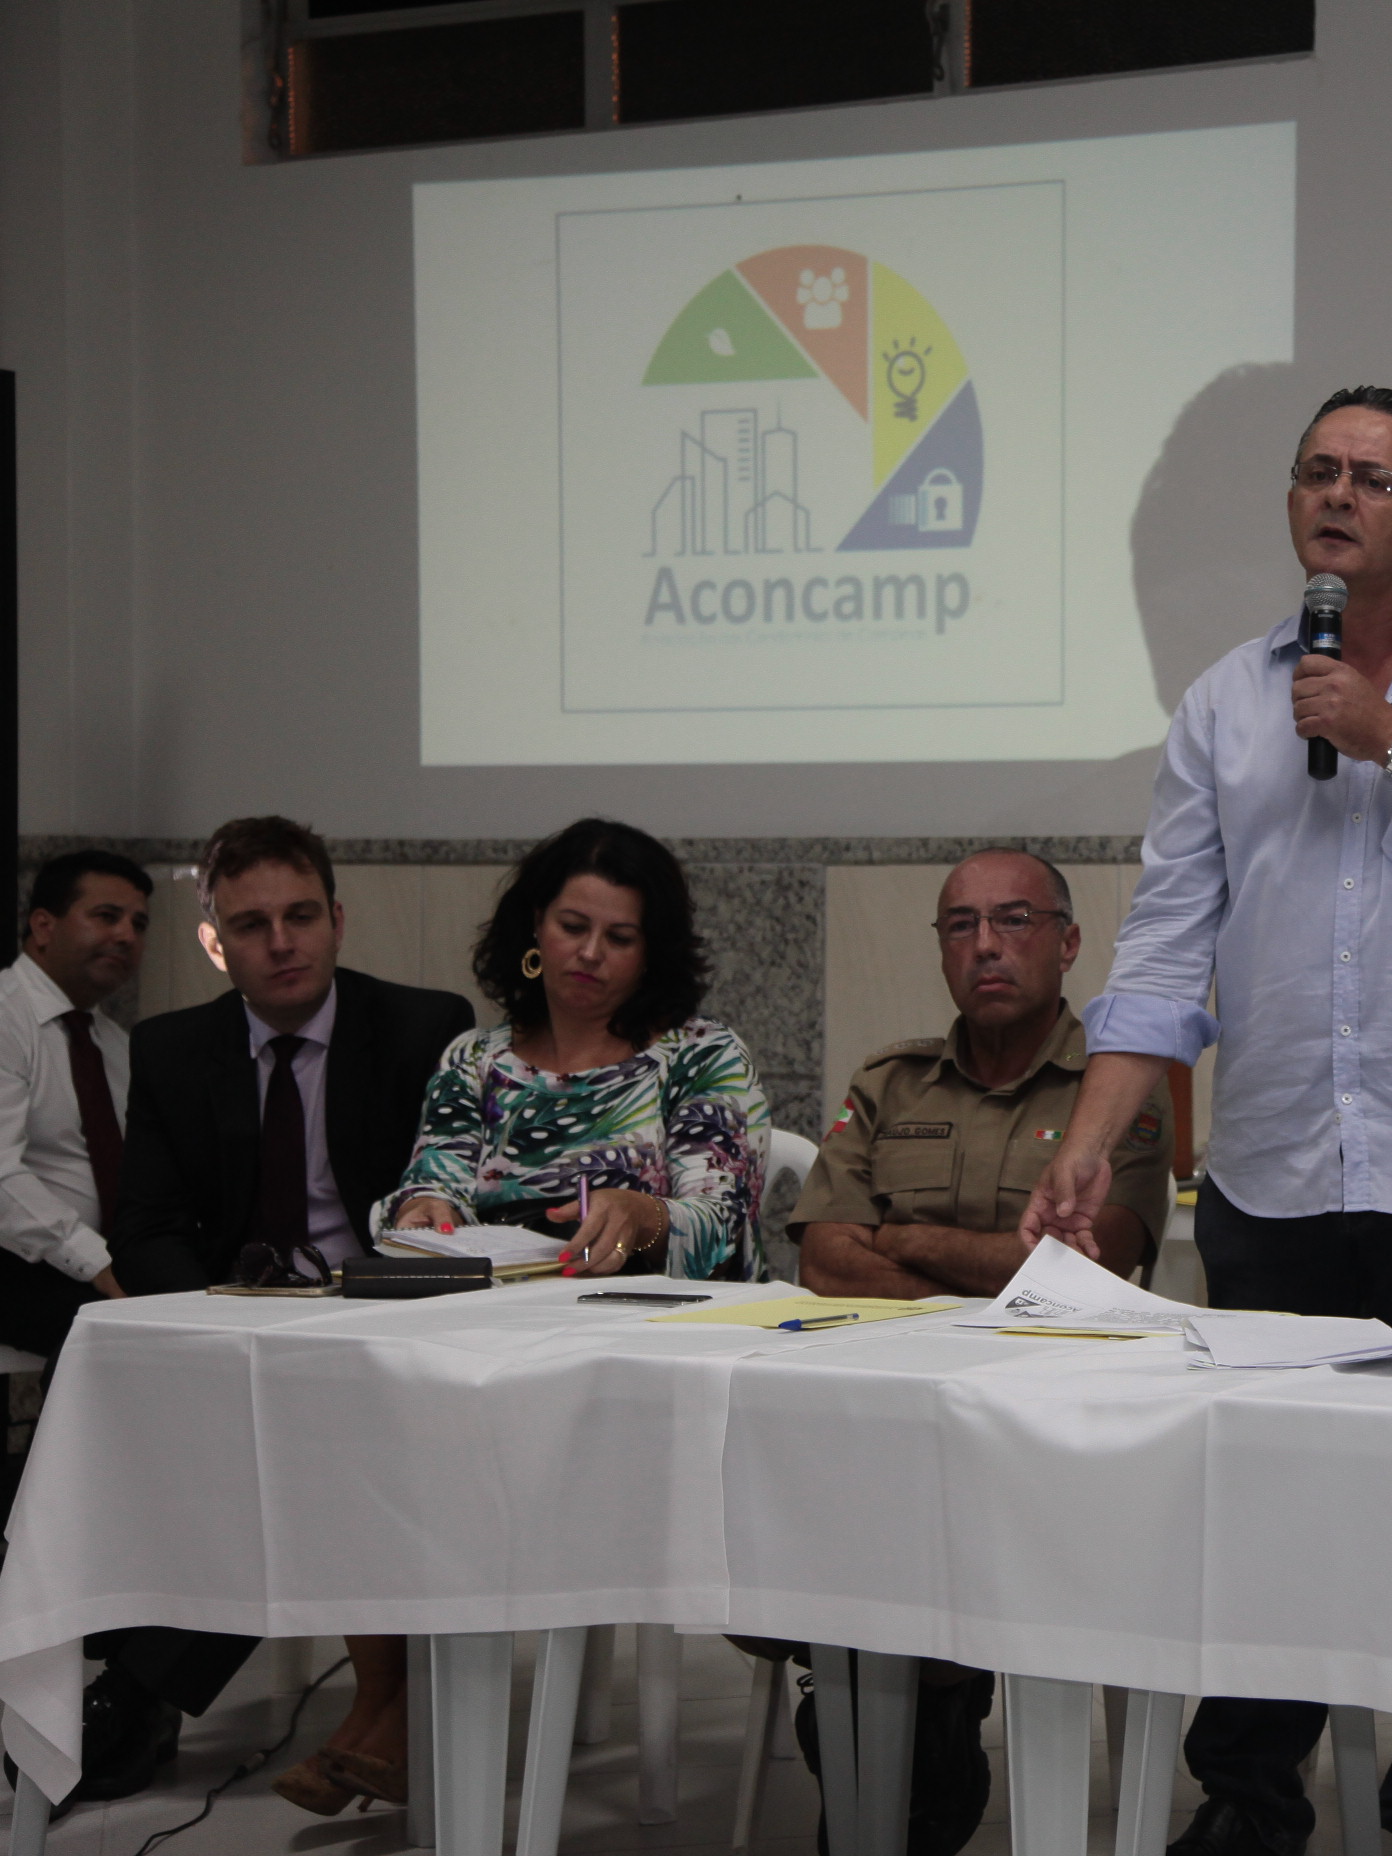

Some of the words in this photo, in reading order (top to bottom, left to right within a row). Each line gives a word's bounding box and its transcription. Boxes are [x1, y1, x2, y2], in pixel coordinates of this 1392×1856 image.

[644, 566, 971, 635] Aconcamp
[914, 1127, 945, 1137] GOMES
[1022, 1289, 1082, 1312] Aconcamp
